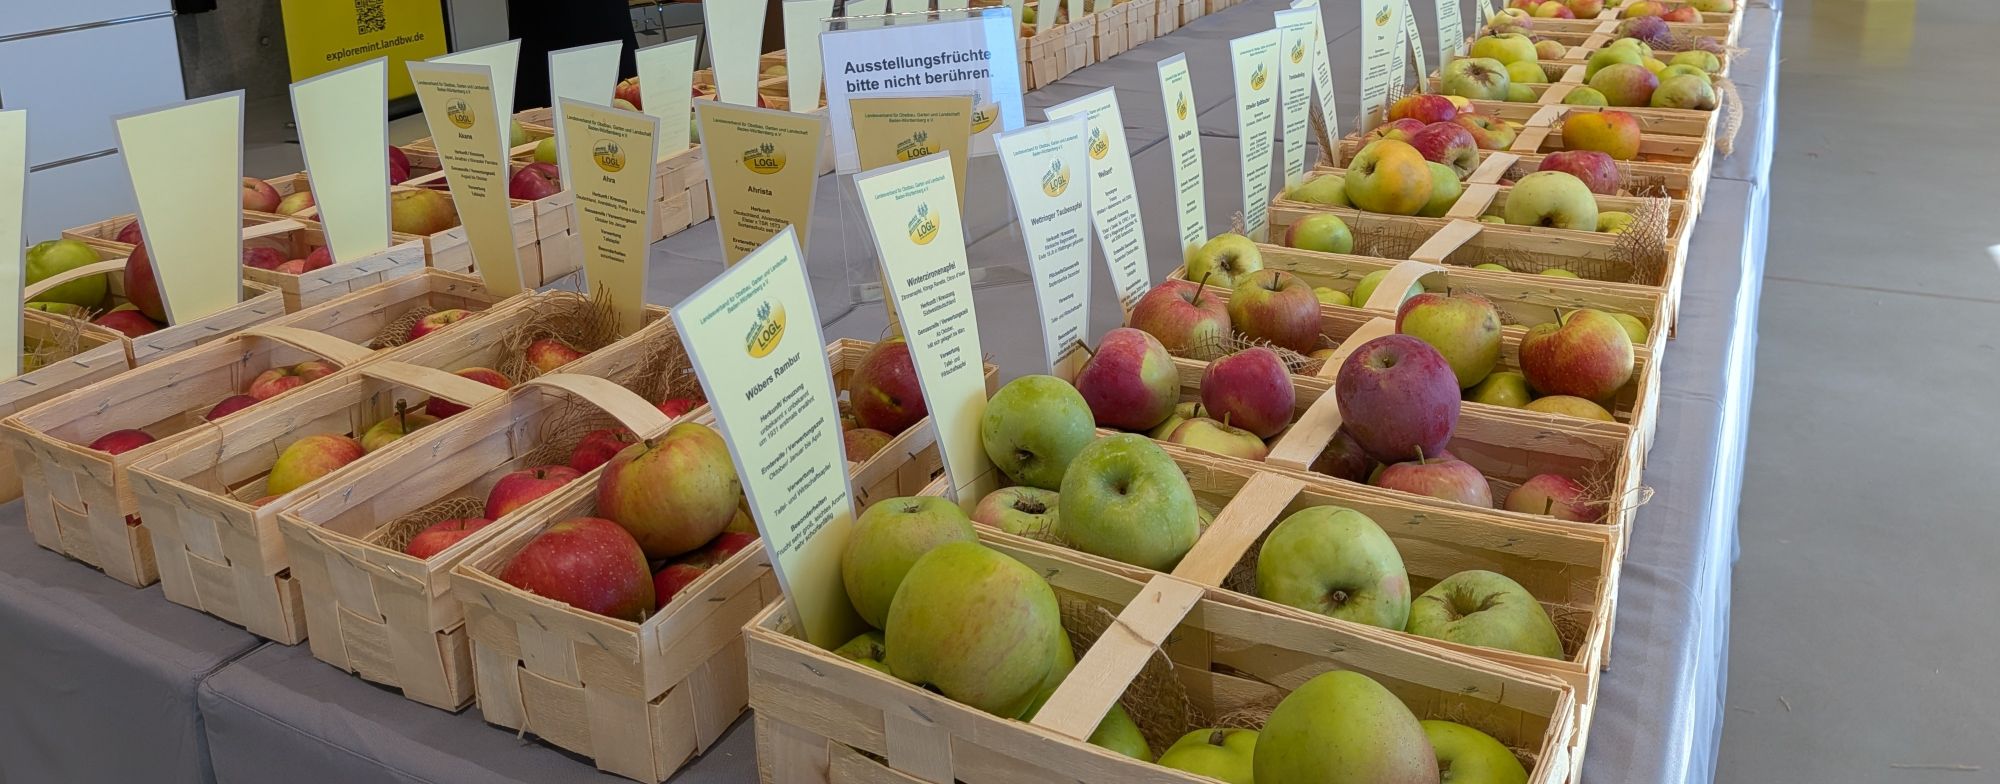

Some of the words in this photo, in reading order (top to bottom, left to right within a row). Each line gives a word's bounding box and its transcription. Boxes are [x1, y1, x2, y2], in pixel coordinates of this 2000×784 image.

[326, 32, 424, 61] exploremint.landbw.de
[844, 49, 991, 74] Ausstellungsfrüchte
[847, 79, 879, 92] bitte
[885, 74, 920, 88] nicht
[926, 67, 993, 84] berühren.
[455, 114, 471, 123] LOGL
[973, 111, 988, 122] GL
[907, 147, 932, 158] LOGL
[1093, 140, 1107, 154] LOGL
[602, 156, 620, 166] LOGL
[603, 175, 615, 183] Ahra
[748, 186, 772, 196] Ahrista
[750, 205, 770, 214] Herkunft
[917, 220, 935, 237] LOGL
[757, 321, 781, 347] LOGL
[745, 375, 774, 401] Wöbers
[771, 352, 800, 379] Rambur
[781, 385, 805, 406] Kreuzung
[761, 411, 784, 435] unbekannt
[787, 390, 810, 414] unbekannt
[766, 425, 779, 440] 1931
[778, 411, 798, 430] erstmals
[797, 394, 815, 414] erwähnt
[761, 452, 785, 475] Erntereife
[787, 416, 825, 453] Verwertungszeit
[788, 447, 804, 464] Januar
[811, 430, 822, 444] April
[774, 502, 788, 517] Tafel-
[787, 492, 797, 506] und
[796, 462, 832, 498] Wirtschaftsapfel
[787, 467, 815, 492] Verwertung
[776, 540, 791, 558] Frucht
[791, 532, 802, 545] sehr
[831, 491, 846, 508] Aroma
[790, 496, 828, 532] Besonderheiten
[794, 538, 805, 551] sehr
